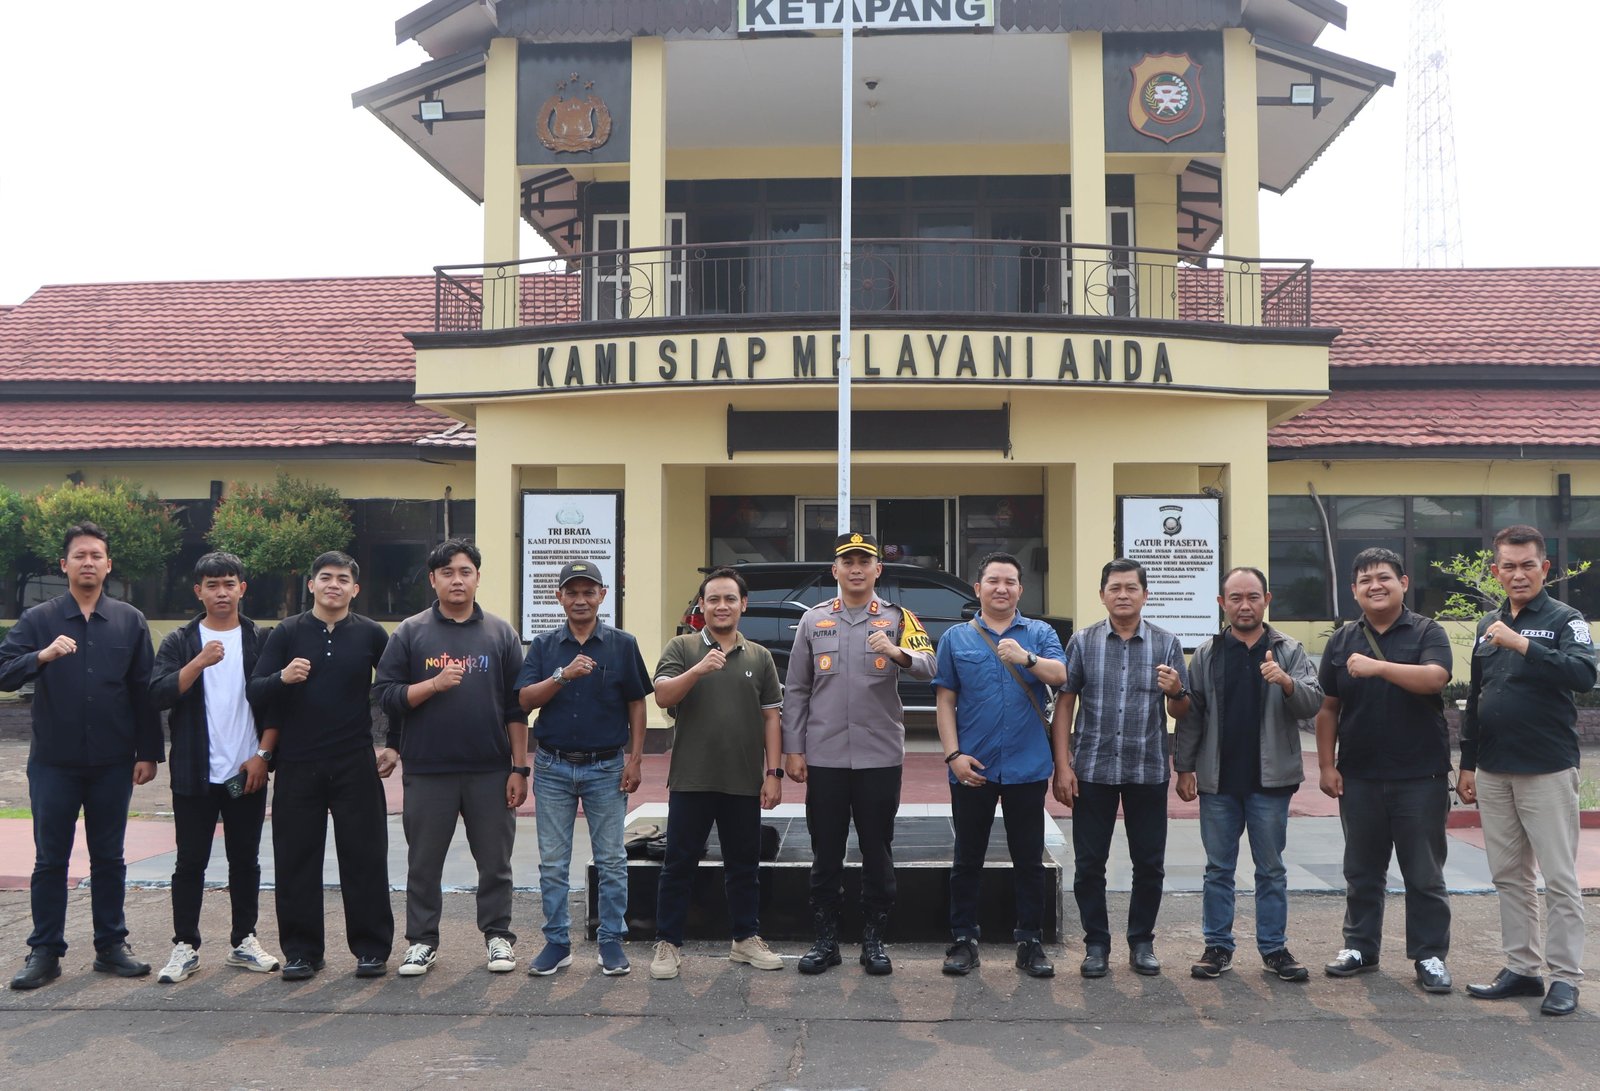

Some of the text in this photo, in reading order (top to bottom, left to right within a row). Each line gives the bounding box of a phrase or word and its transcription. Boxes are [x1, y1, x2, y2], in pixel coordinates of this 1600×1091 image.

[537, 341, 636, 387] KAMI
[658, 337, 767, 380] SIAP
[1058, 338, 1173, 383] ANDA
